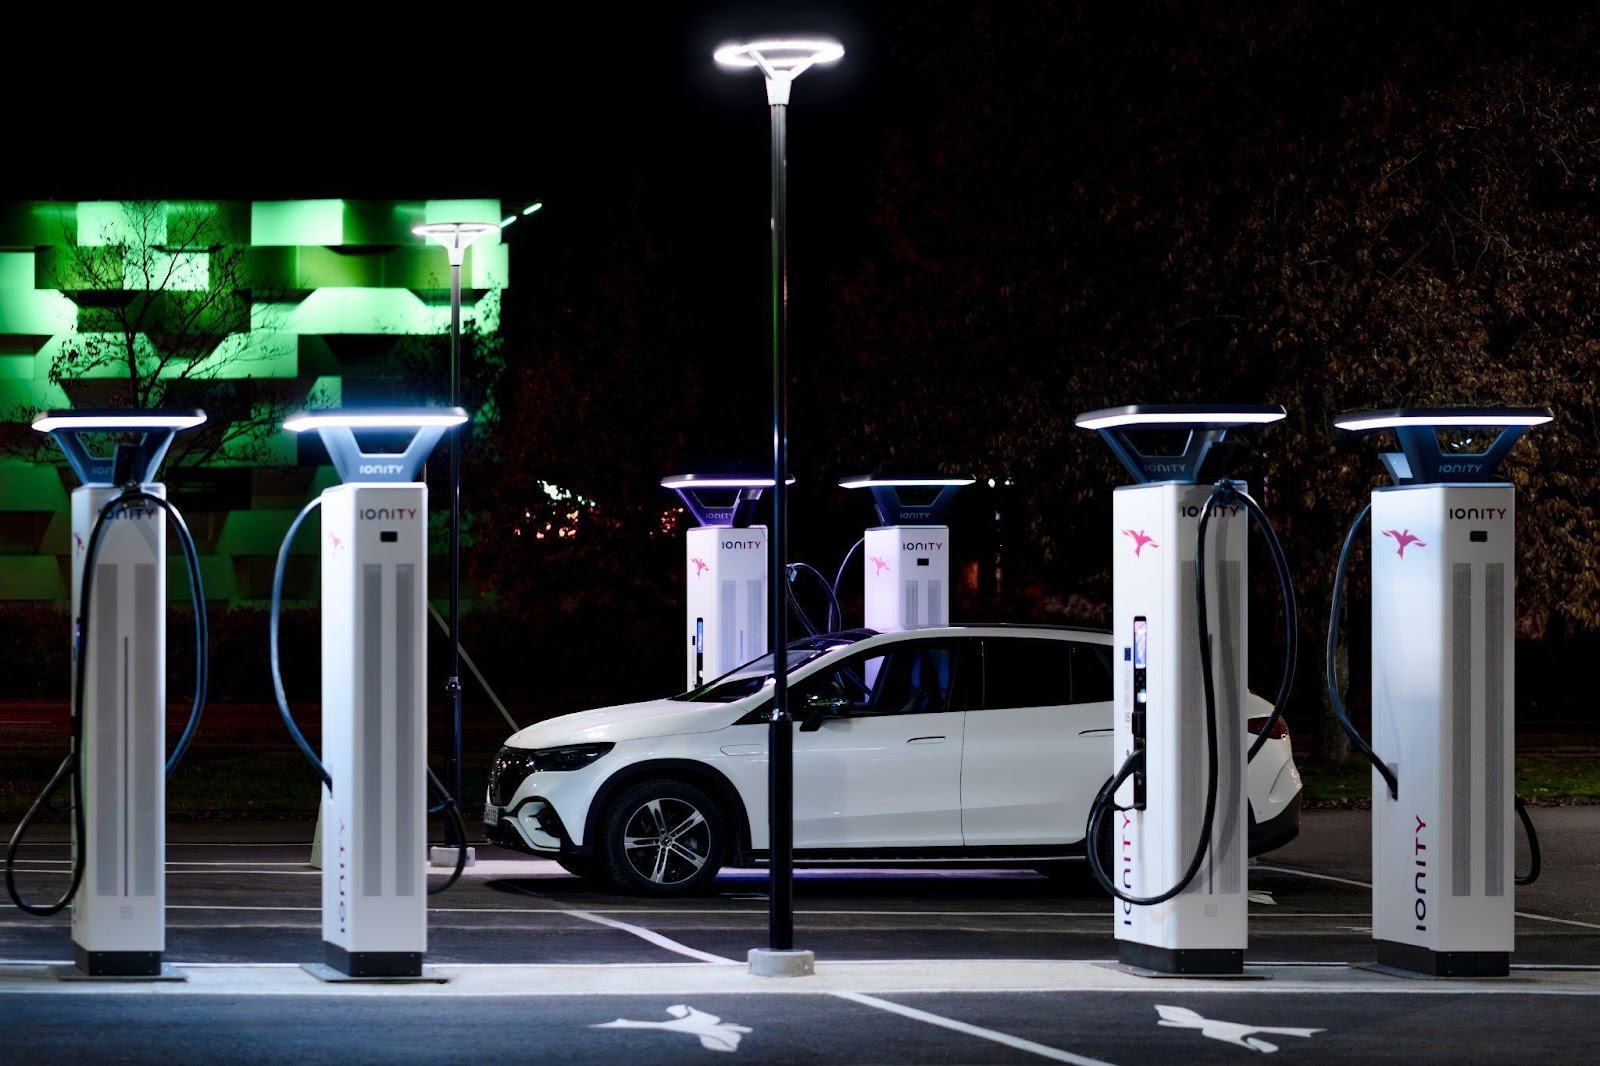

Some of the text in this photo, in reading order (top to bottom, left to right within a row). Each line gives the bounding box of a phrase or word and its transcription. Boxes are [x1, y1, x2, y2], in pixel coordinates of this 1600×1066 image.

[359, 464, 404, 475] IONITY
[1143, 463, 1186, 473] IONITY
[1438, 464, 1484, 474] IONITY
[359, 508, 417, 520] IONITY
[899, 512, 931, 520] IONITY
[1182, 506, 1240, 517] IOITY
[1449, 508, 1507, 520] IONITY
[721, 541, 761, 549] IONITY
[902, 542, 943, 551] IONITY
[1122, 810, 1132, 926] IONITY
[1415, 813, 1427, 932] IONITY
